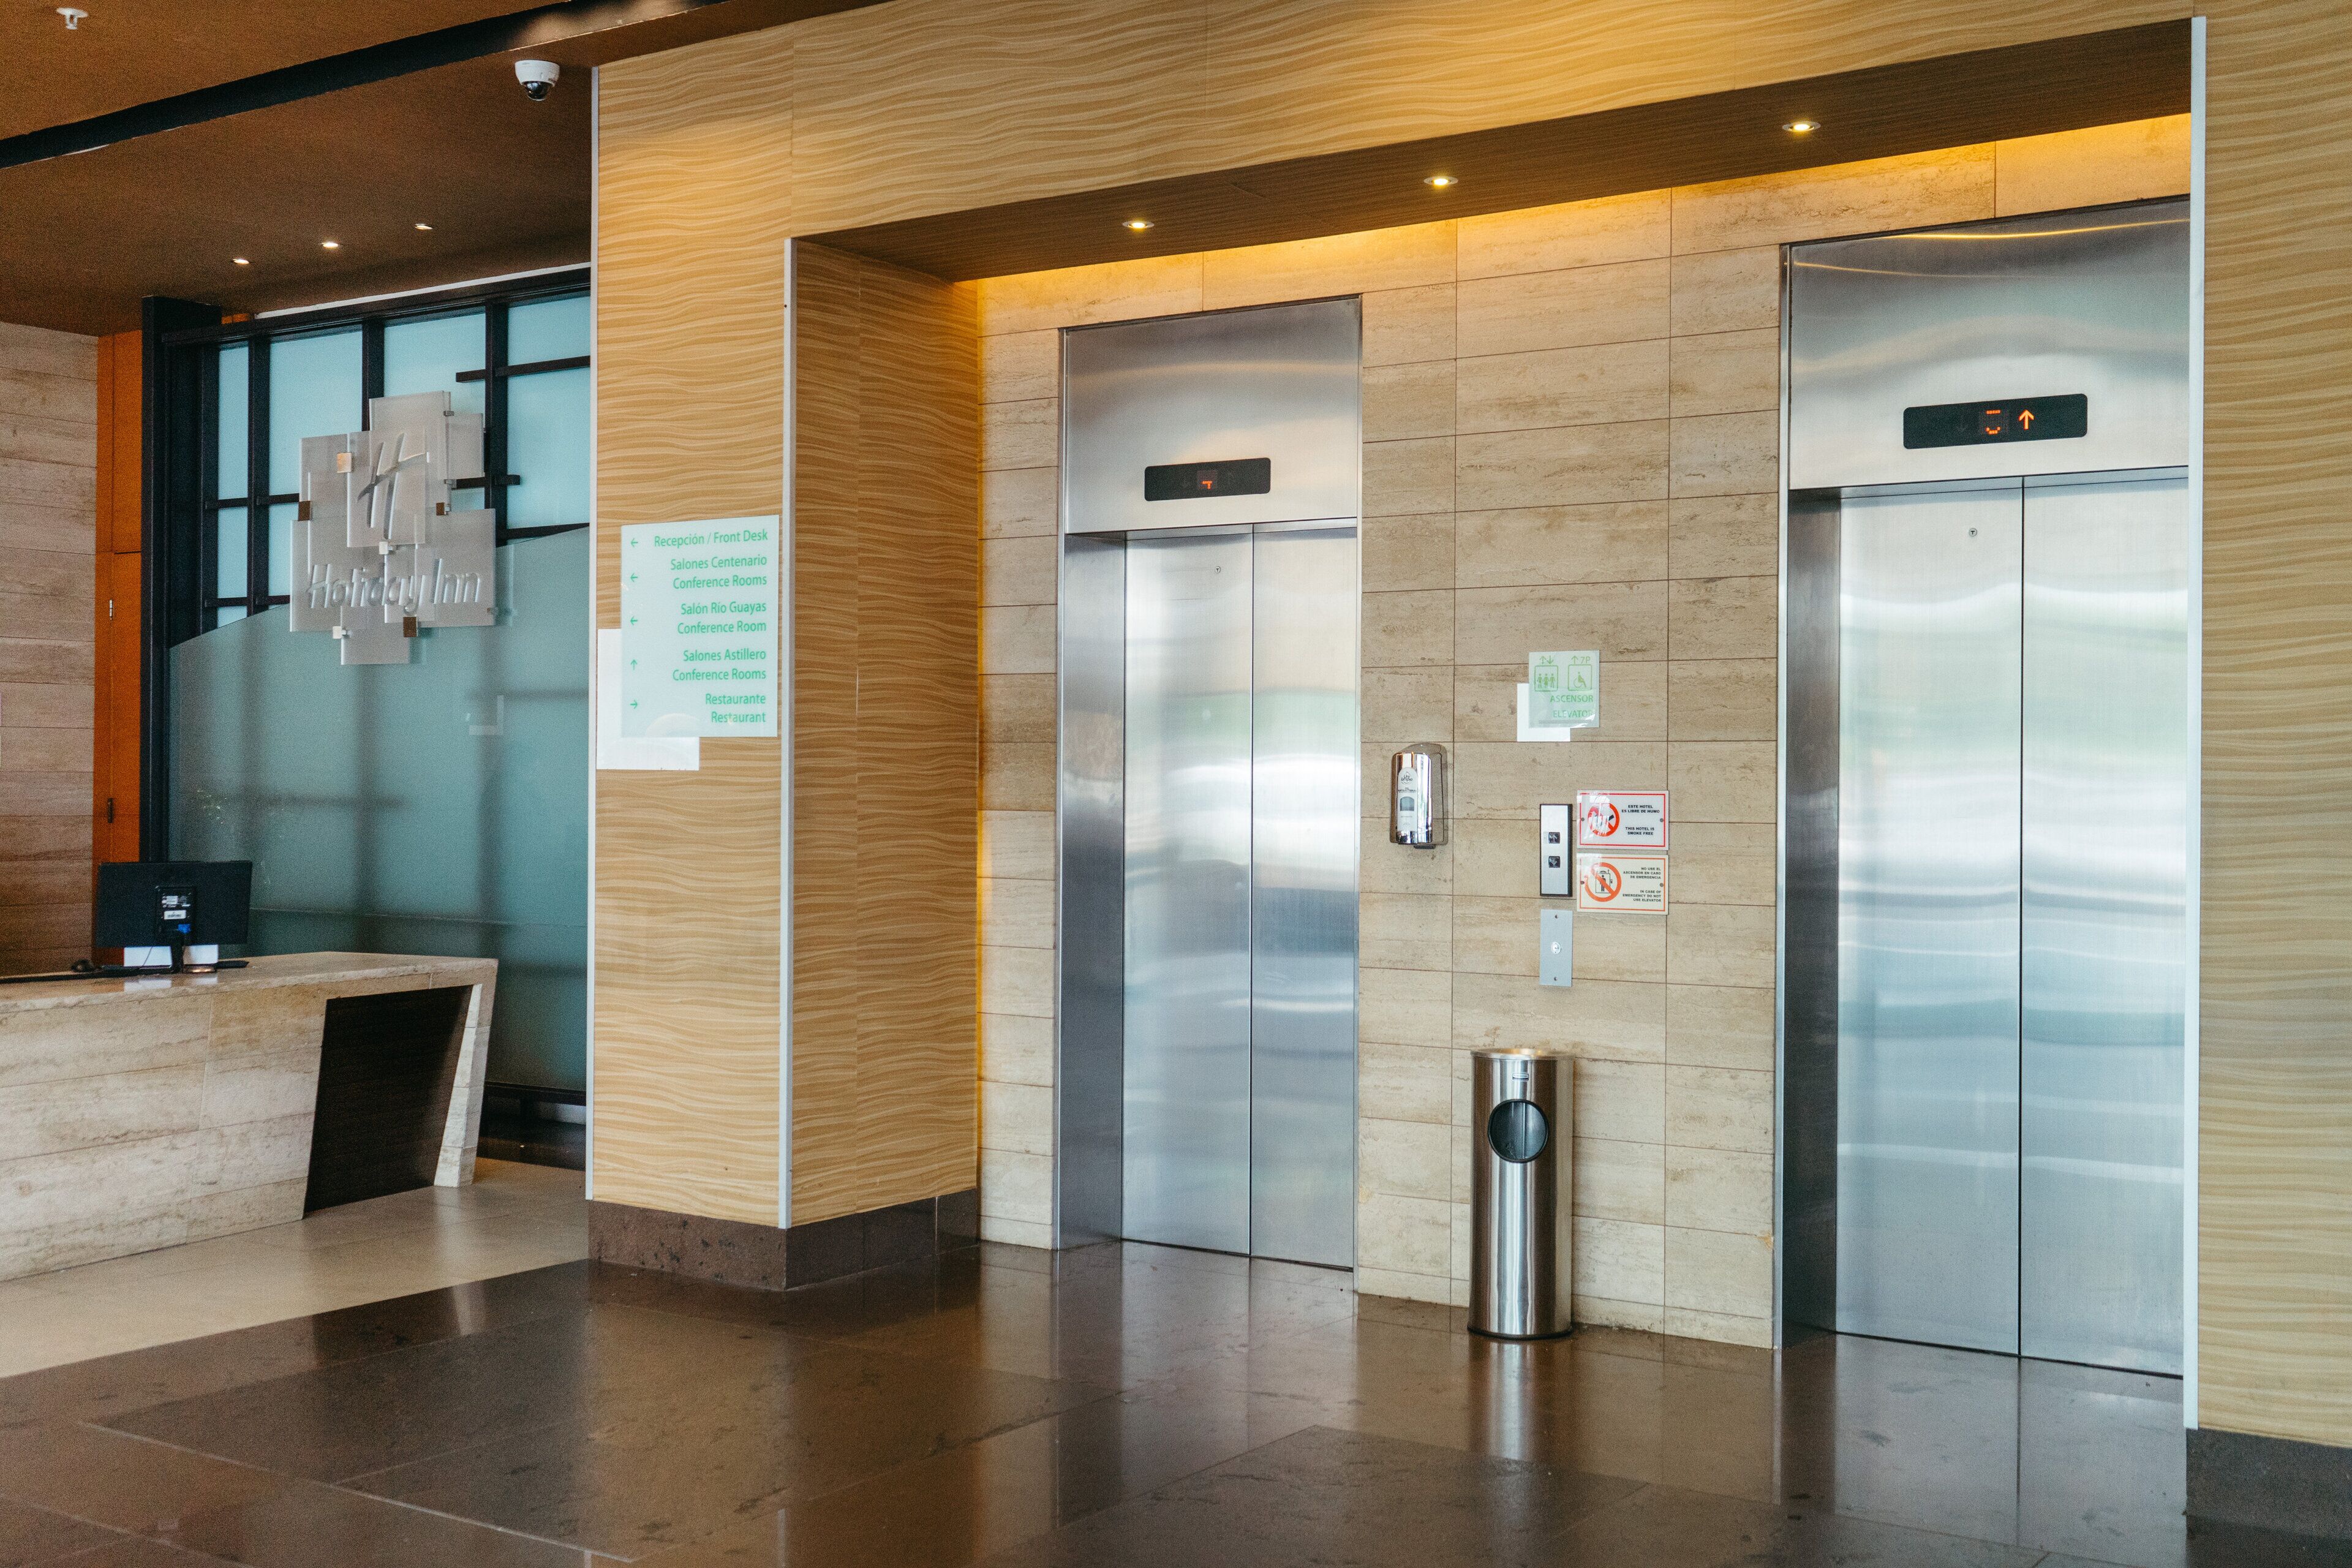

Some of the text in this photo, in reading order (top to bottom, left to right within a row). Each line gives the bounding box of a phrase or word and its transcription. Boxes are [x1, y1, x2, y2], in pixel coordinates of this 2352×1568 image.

[654, 529, 768, 549] Recepción / Front Desk
[671, 554, 767, 571] Salones Centenario
[432, 558, 484, 605] Inn
[673, 575, 767, 590] Conference Rooms
[681, 601, 767, 616] Salón Río Guayas
[677, 620, 767, 635] Conference Room
[683, 647, 767, 662] Salones Astillero
[673, 668, 767, 681] Conference Rooms
[705, 693, 766, 705] Restaurante
[1550, 695, 1594, 703] ASCENSOR
[711, 710, 766, 723] Restaurant
